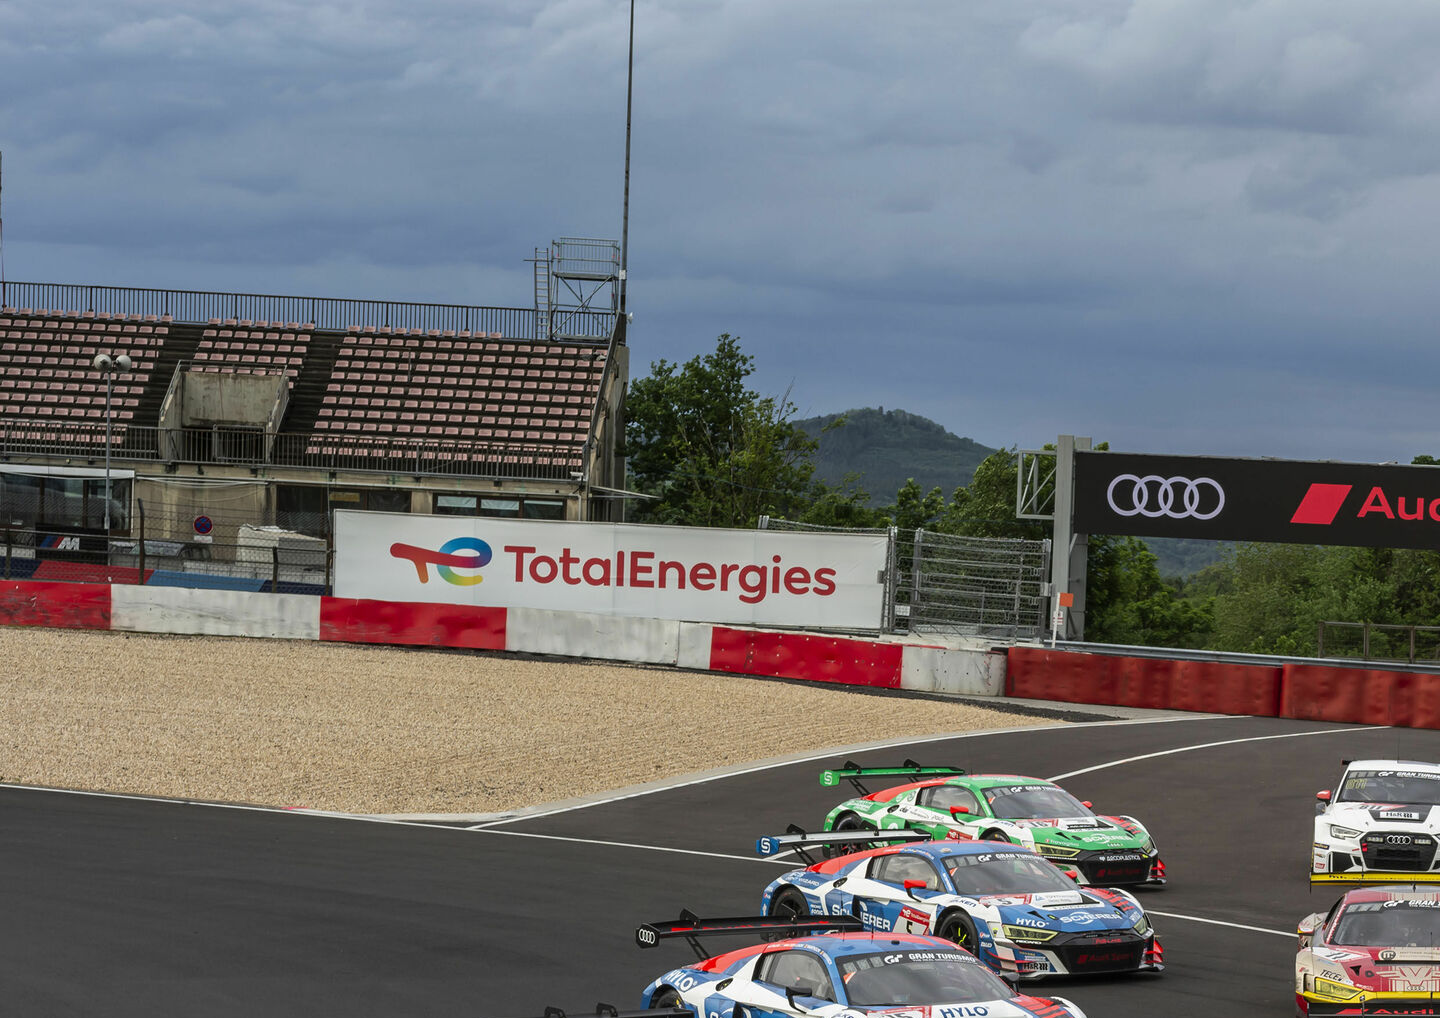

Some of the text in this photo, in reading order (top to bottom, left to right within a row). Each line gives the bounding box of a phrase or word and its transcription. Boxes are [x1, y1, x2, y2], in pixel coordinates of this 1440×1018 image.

[504, 544, 837, 604] TotalEnergies
[1016, 917, 1047, 928] HYLO
[1060, 912, 1123, 924] SCHERER
[908, 953, 936, 961] GRAN
[936, 953, 976, 963] TURISMO
[665, 970, 695, 992] HYLO
